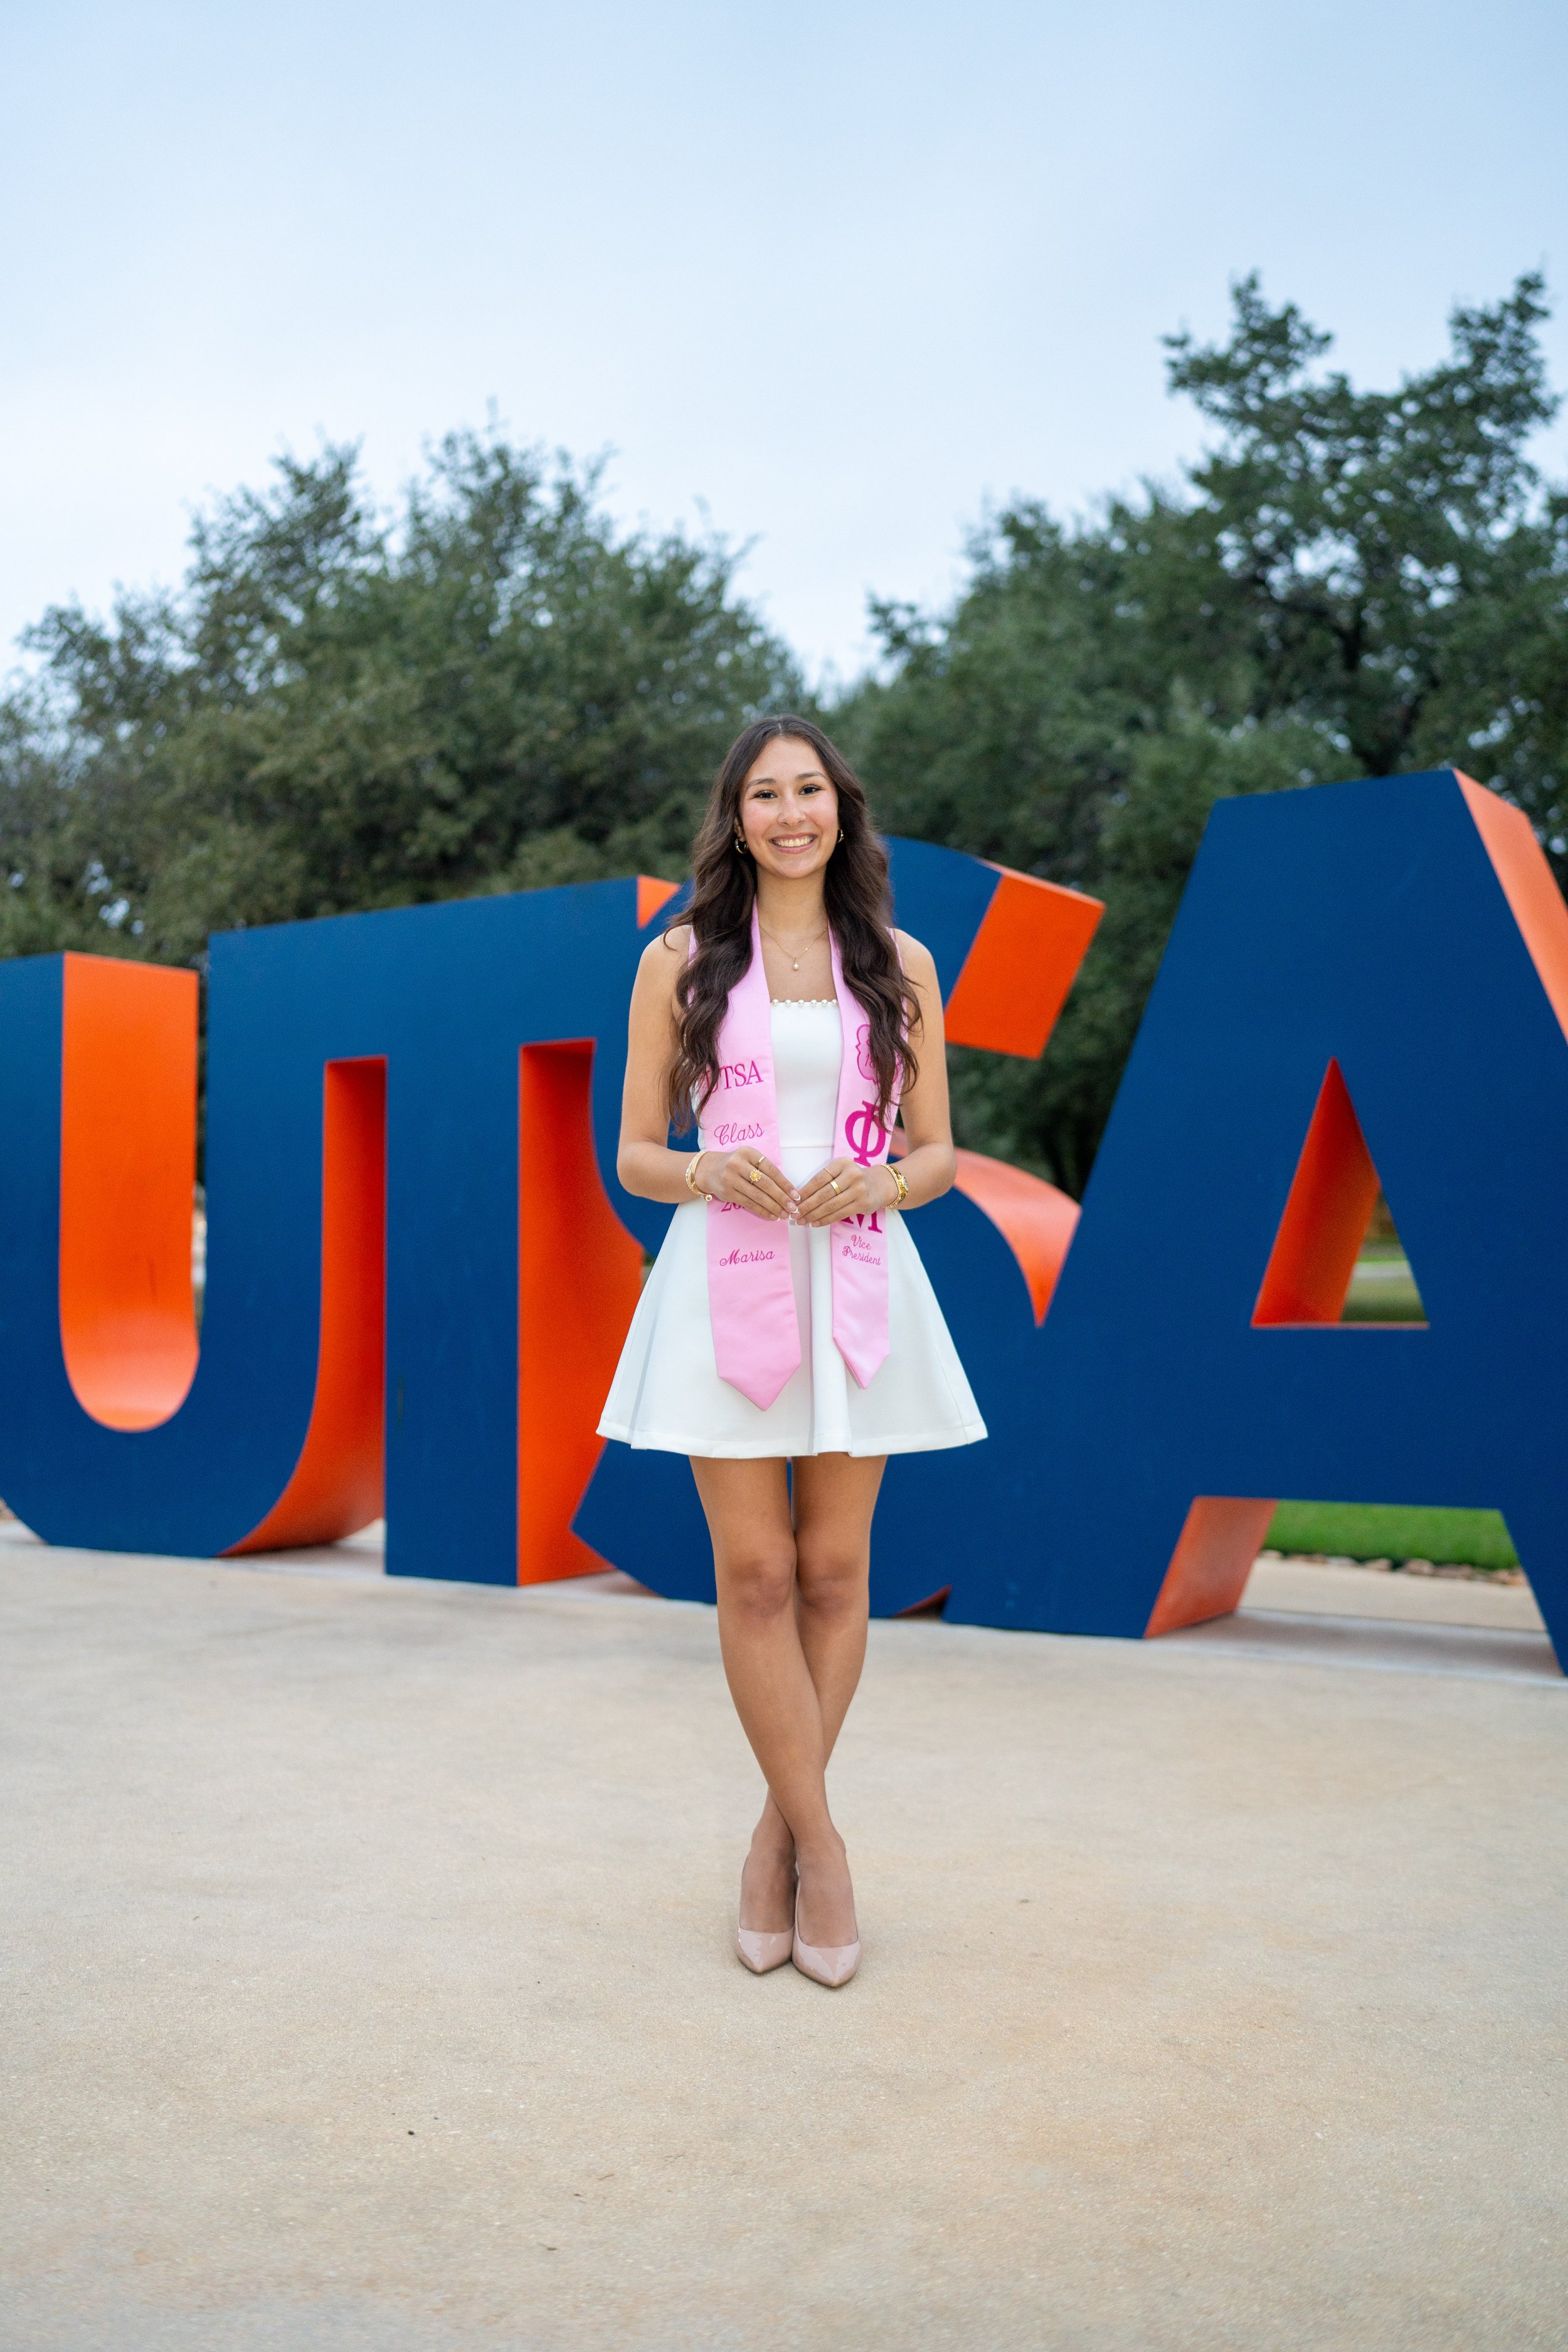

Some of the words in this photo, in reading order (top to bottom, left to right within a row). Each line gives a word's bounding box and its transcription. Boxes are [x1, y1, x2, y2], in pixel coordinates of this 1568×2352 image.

[714, 1122, 765, 1146] Class
[851, 1234, 872, 1250] Vice
[719, 1248, 775, 1266] Marisa
[842, 1246, 882, 1266] President
